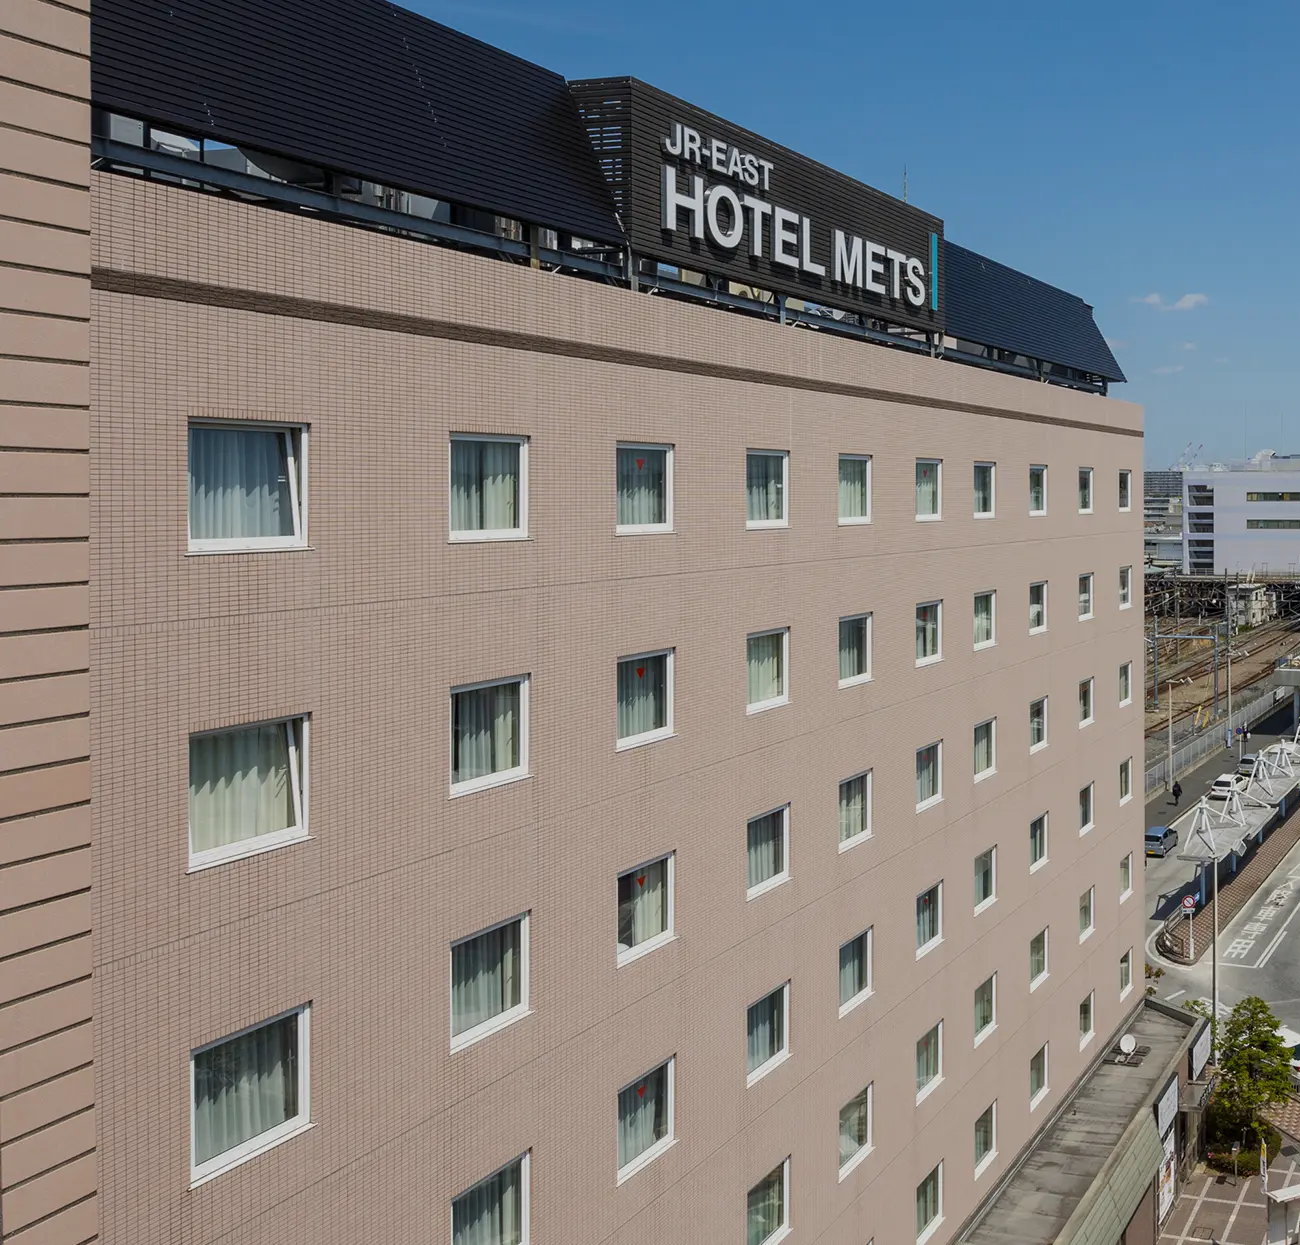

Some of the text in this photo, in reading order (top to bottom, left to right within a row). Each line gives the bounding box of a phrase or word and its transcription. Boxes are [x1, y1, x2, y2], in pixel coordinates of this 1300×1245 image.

[664, 121, 774, 192] JR-EAST
[661, 163, 926, 307] HOTEL METS
